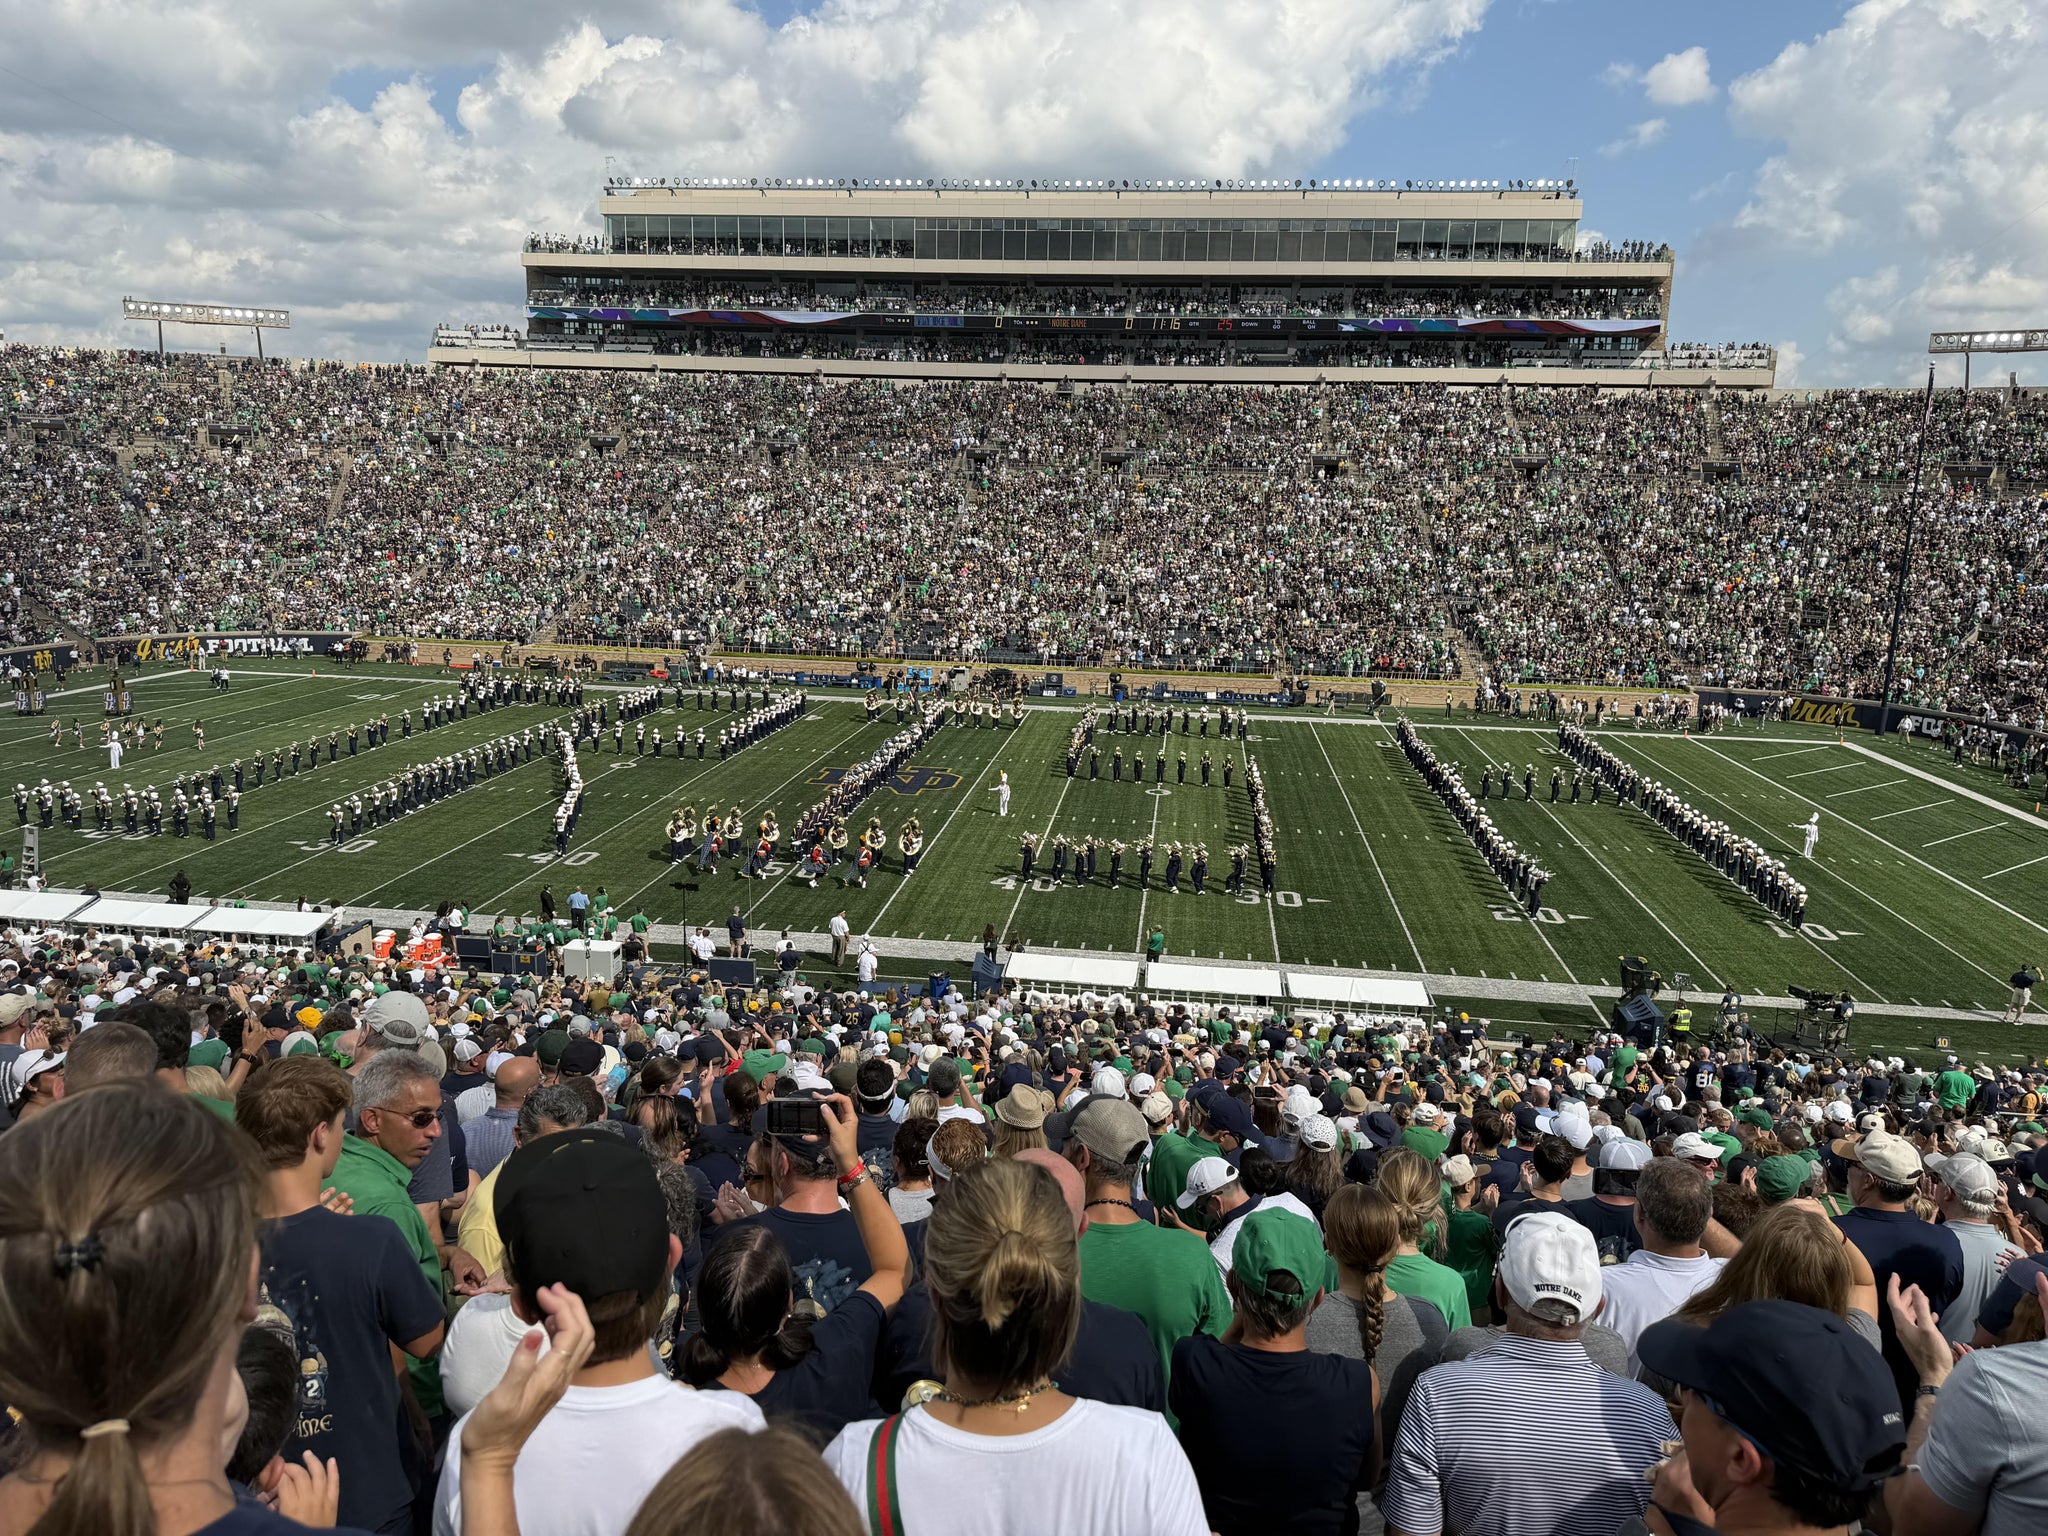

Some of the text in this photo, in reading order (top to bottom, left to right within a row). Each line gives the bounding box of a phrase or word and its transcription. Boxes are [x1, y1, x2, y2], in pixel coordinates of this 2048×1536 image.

[1051, 319, 1087, 328] NOTRE DAME
[1152, 318, 1181, 330] 11:16
[206, 638, 314, 654] FOOTBAL
[527, 851, 600, 866] 40
[990, 874, 1057, 892] 40
[1234, 888, 1303, 908] 30
[1487, 904, 1566, 925] 20
[1763, 920, 1839, 941] 10
[846, 1011, 860, 1026] 26
[1937, 1037, 1949, 1048] 10
[1695, 1072, 1714, 1088] 81
[1533, 1283, 1583, 1304] NOTRE DAME
[305, 1378, 319, 1398] 2
[292, 1411, 333, 1438] AME
